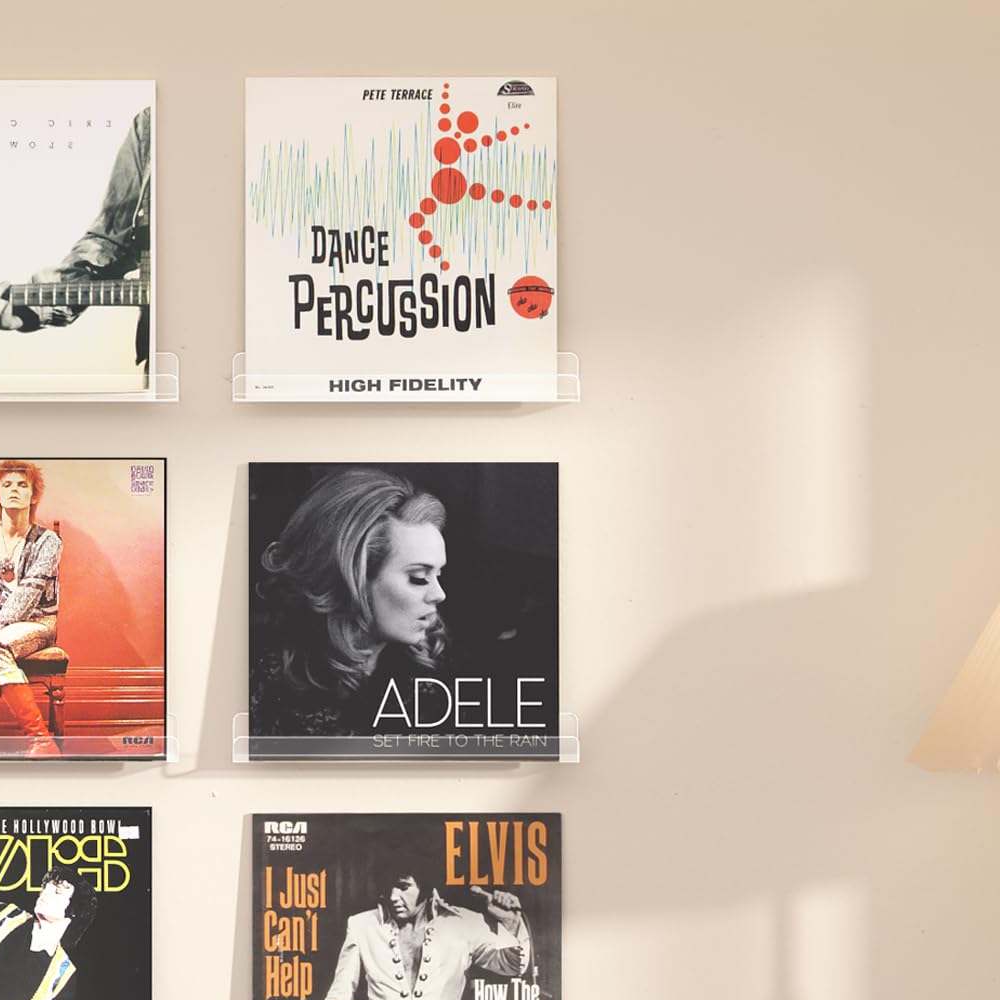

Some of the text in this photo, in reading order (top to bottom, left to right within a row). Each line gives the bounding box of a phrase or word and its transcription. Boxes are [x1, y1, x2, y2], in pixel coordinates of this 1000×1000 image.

[362, 89, 433, 100] PETE TERRACE
[311, 225, 389, 273] DANCE
[289, 272, 496, 341] PERCUSSION
[329, 378, 482, 392] HIGH FIDELITY
[373, 678, 546, 728] ADELE
[123, 736, 154, 745] RCA
[373, 734, 548, 748] SET FIRE TO THE RAIN
[13, 819, 85, 835] HOLLYWOOD
[264, 821, 308, 834] RCA
[266, 835, 306, 843] 74-16126
[269, 843, 303, 851] STEREO
[445, 821, 548, 886] ELVIS
[265, 867, 327, 909] I Just
[264, 911, 319, 953] Can't
[265, 956, 313, 1000] Help
